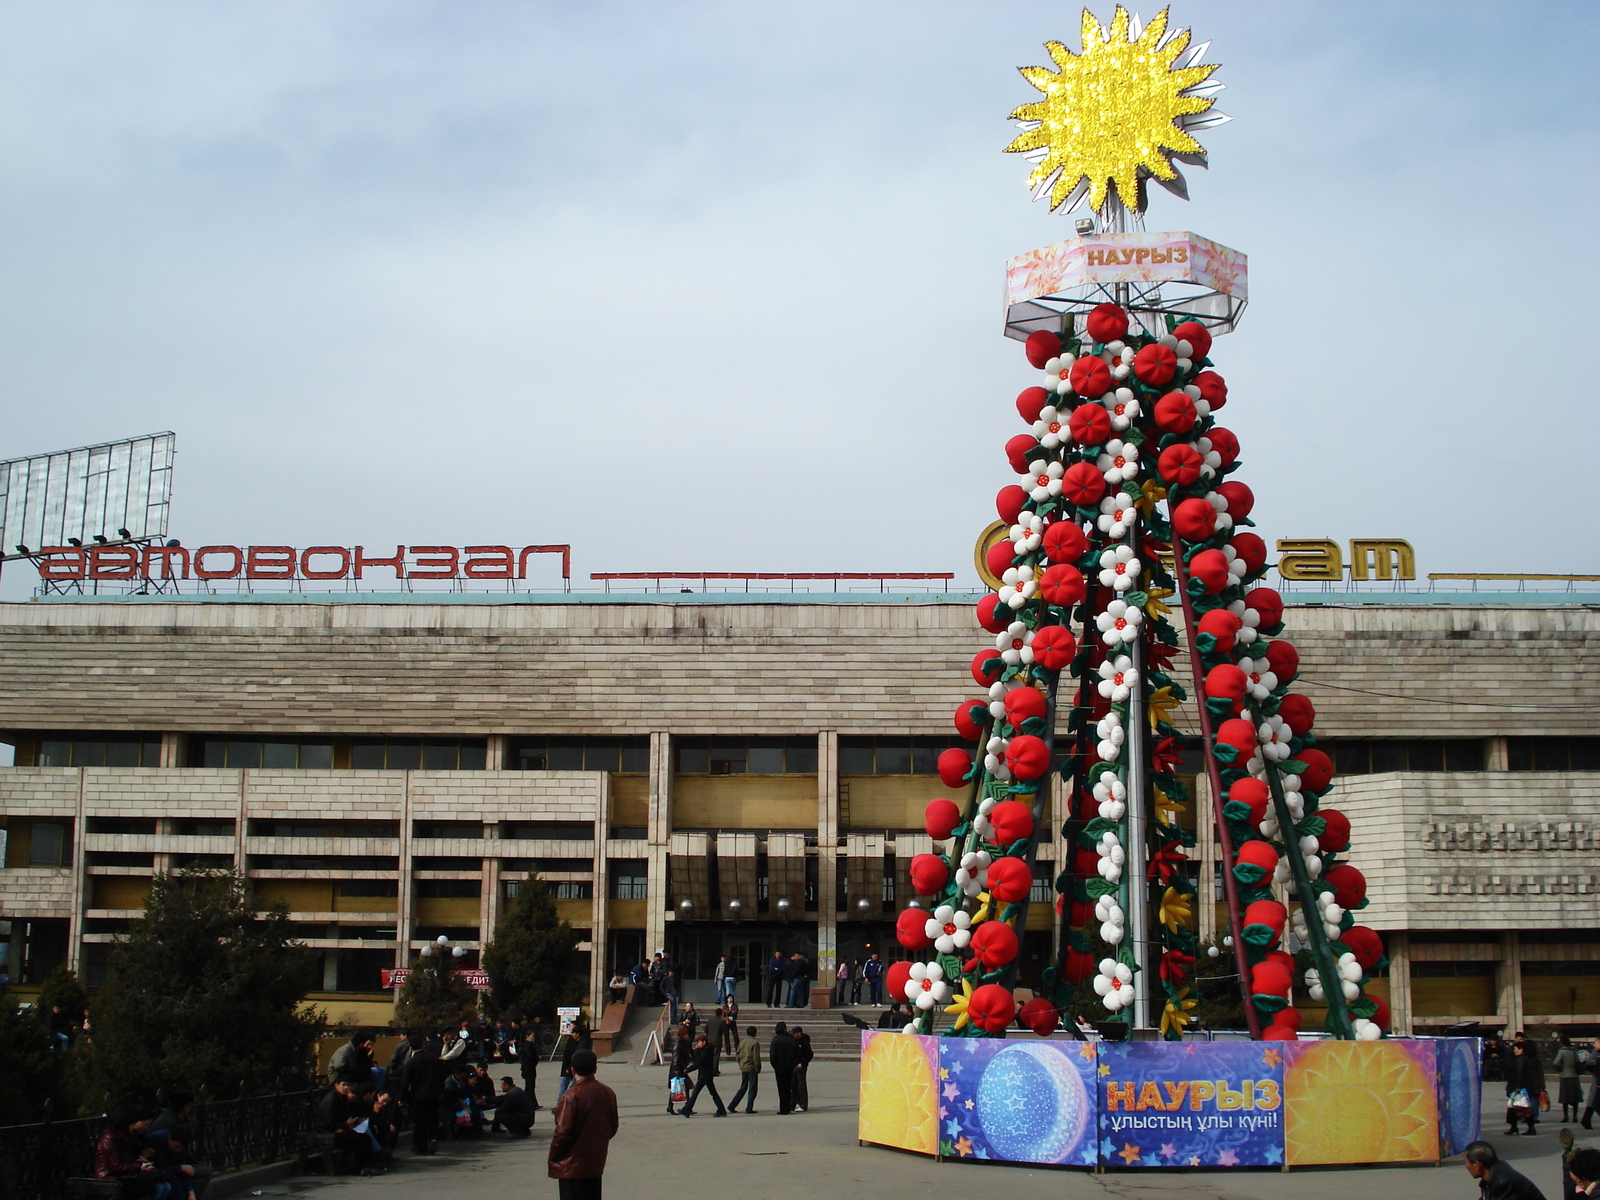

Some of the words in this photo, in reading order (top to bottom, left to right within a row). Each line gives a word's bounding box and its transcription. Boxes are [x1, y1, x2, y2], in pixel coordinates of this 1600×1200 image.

[1087, 247, 1188, 266] НАУРЫЗ
[1106, 1079, 1281, 1111] НАУРЫЗ
[1197, 1115, 1233, 1132] ұлы
[1238, 1112, 1277, 1132] күні!
